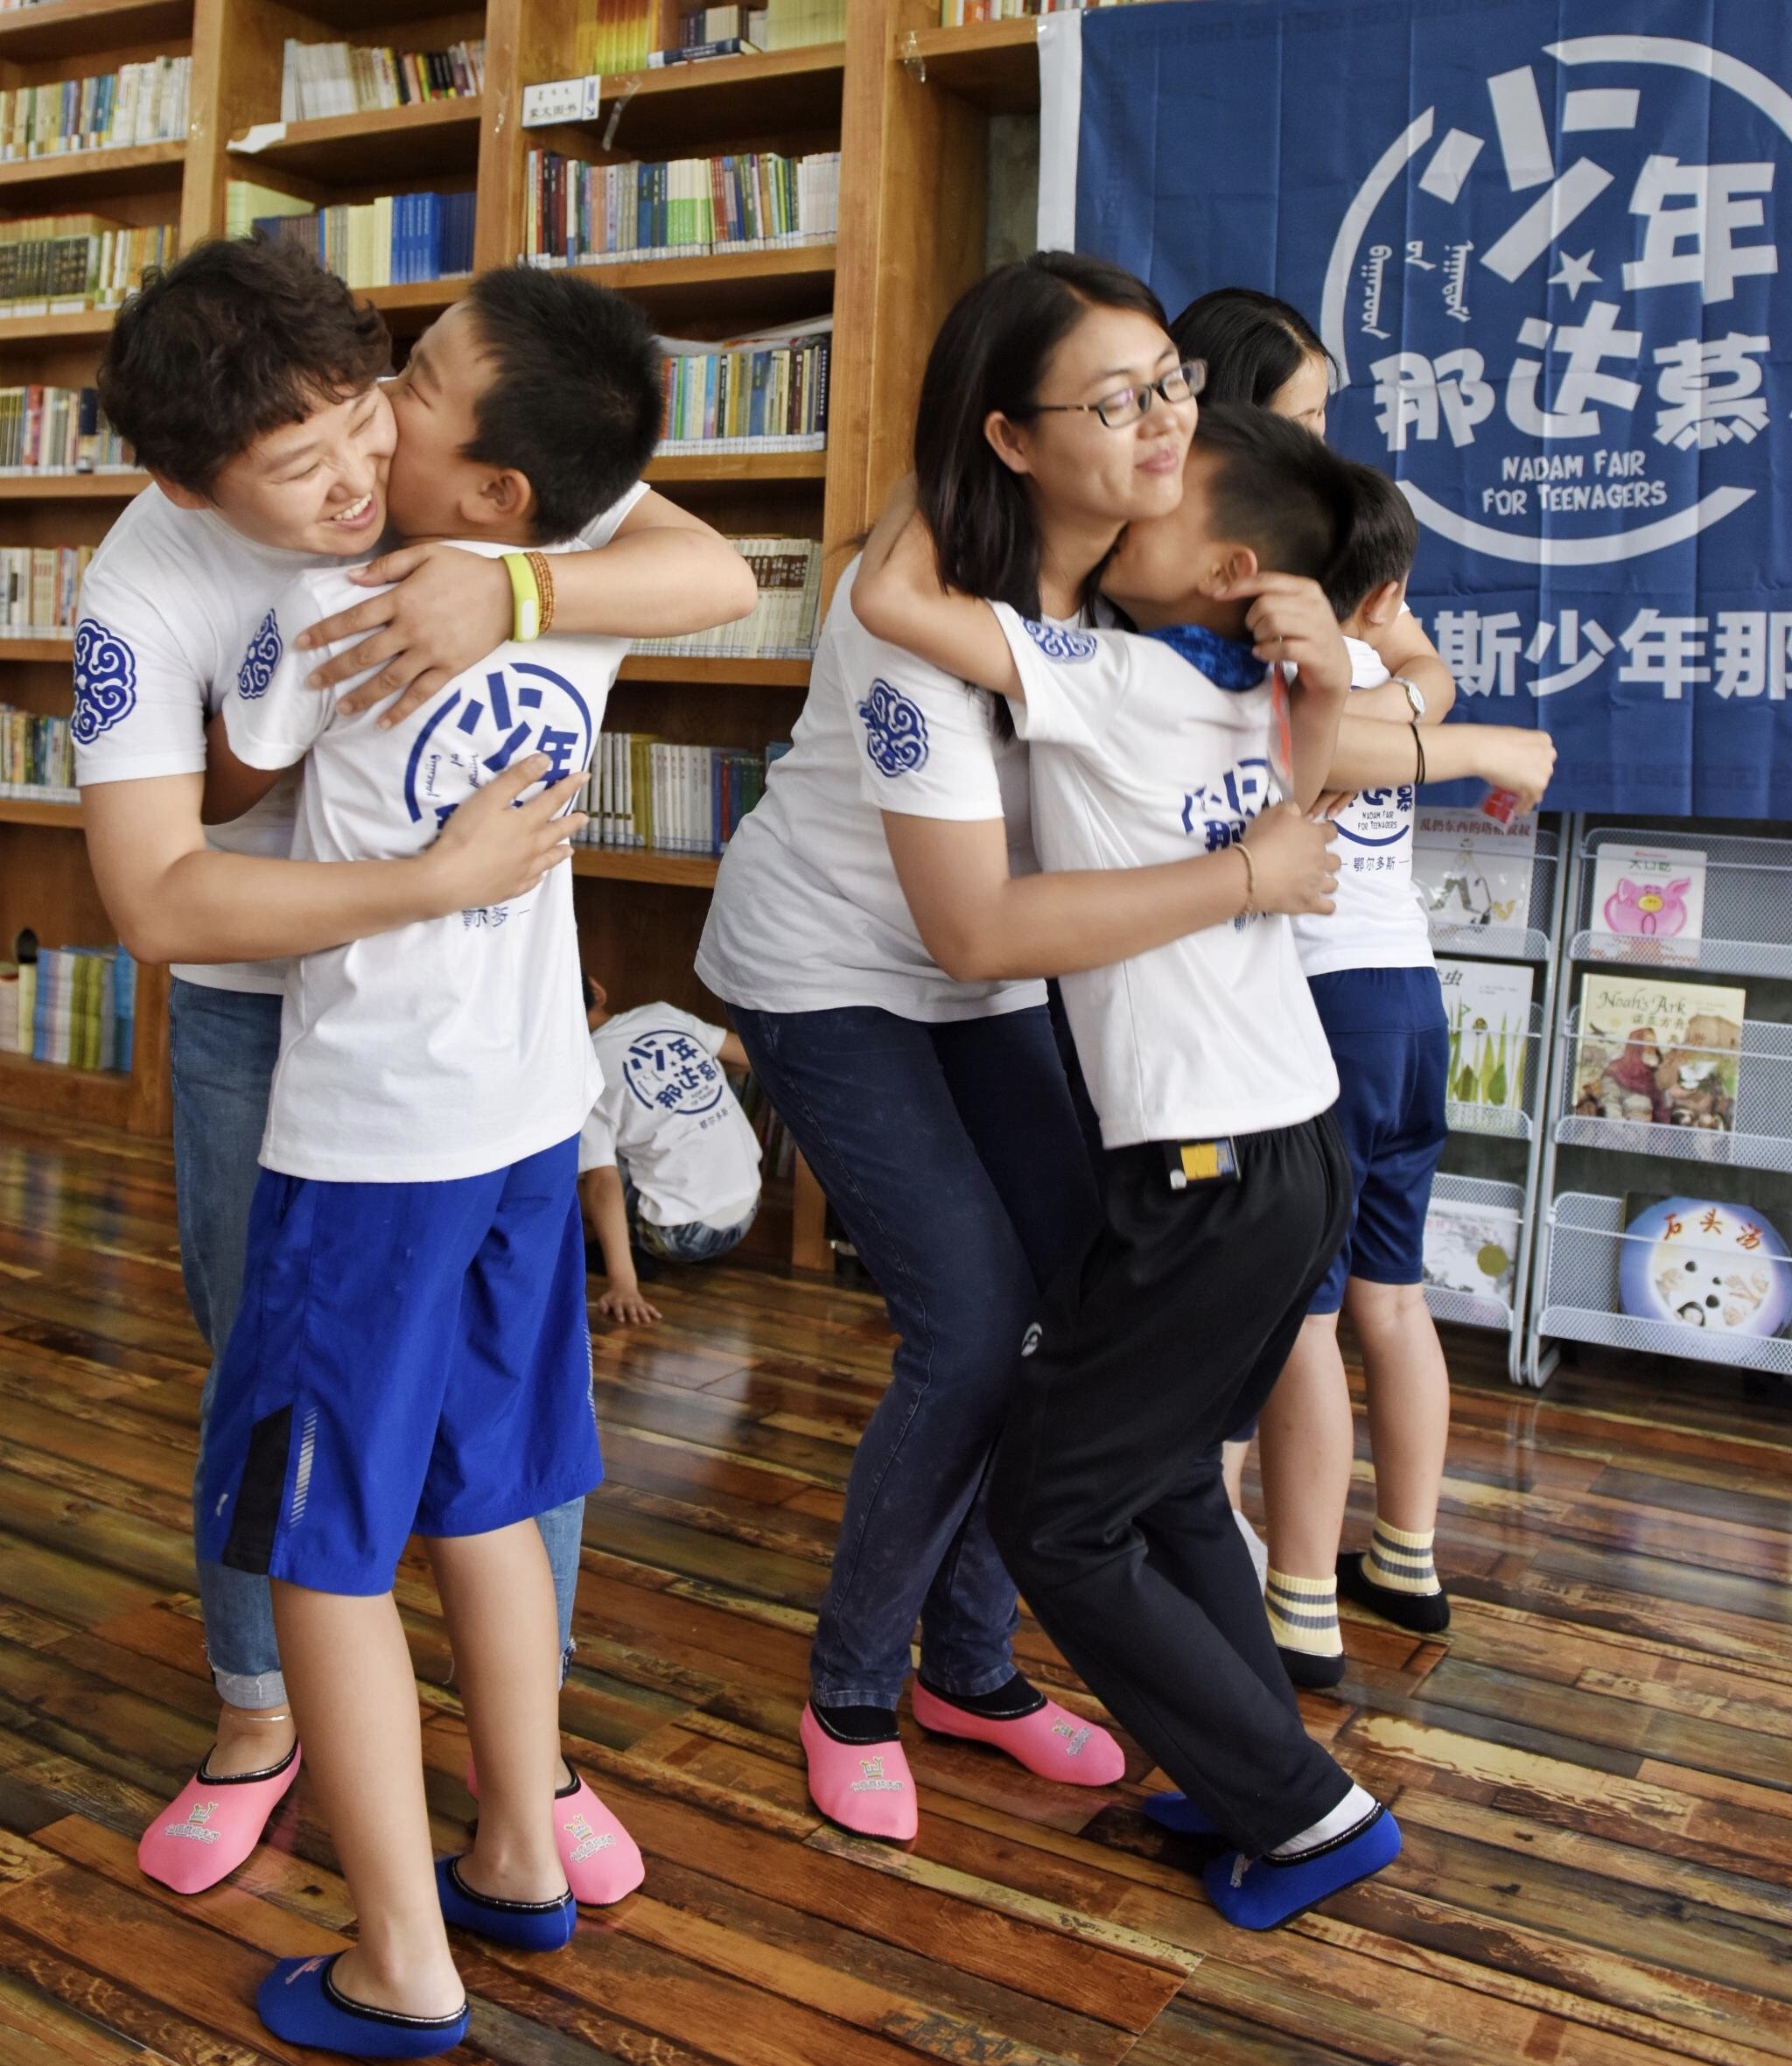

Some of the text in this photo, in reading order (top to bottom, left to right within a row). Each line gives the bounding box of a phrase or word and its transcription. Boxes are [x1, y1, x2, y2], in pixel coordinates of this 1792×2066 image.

[1418, 64, 1778, 305] 少年
[1369, 300, 1771, 457] 那达慕
[1502, 450, 1646, 483] NADAM FAIR
[1482, 480, 1668, 515] FOR TEENAGERS
[1415, 608, 1792, 701] 斯少年那
[1357, 822, 1368, 831] FOR
[1362, 811, 1381, 820] NADAM
[1354, 856, 1396, 872] 鄂尔多斯
[1597, 987, 1649, 1010] Noah's
[1651, 992, 1687, 1015] Ark
